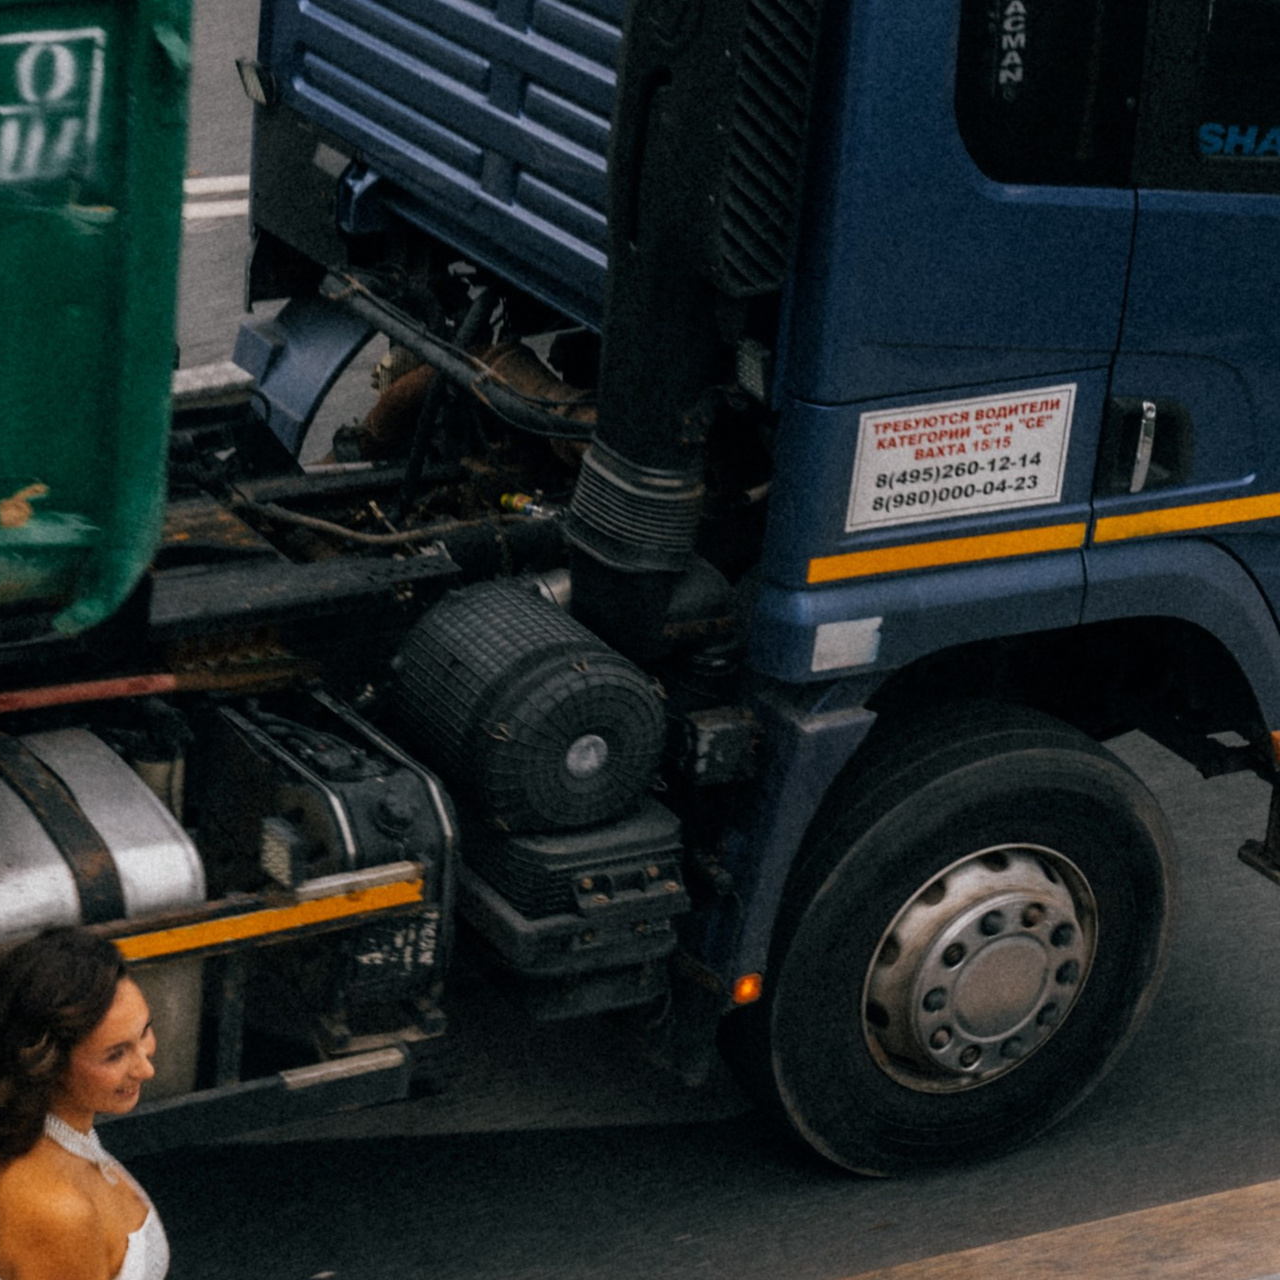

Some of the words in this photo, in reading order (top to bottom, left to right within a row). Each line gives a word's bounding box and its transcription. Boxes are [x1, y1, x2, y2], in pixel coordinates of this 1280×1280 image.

[873, 411, 970, 435] ТРЕБУЮТСЯ
[975, 399, 1061, 421] ВОДИТЕЛИ
[877, 427, 971, 451] КАТЕГОРИИ
[914, 442, 967, 461] ВАХТА
[875, 451, 1042, 490] 8(495)260-12-14
[872, 474, 1039, 513] 8(980)000-04-23
